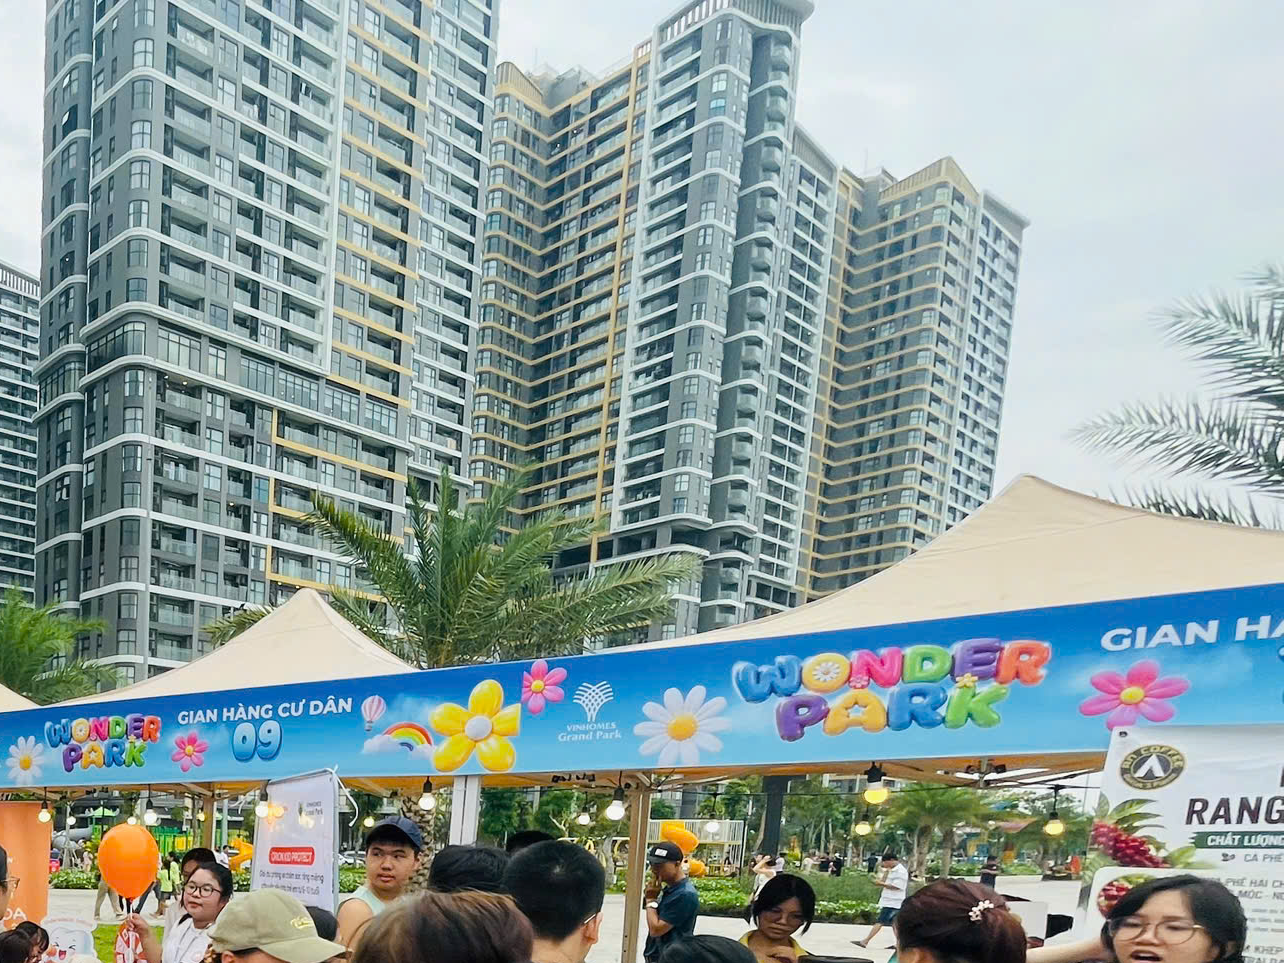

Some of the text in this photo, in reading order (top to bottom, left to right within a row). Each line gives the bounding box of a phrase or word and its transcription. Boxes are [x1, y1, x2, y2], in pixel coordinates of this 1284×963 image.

[1100, 620, 1220, 651] GIAN
[731, 637, 1052, 704] WONDER
[177, 695, 353, 725] GIAN HÀNG CƯ DÂN
[774, 680, 1011, 742] PARK
[44, 713, 162, 749] WONDER
[232, 720, 282, 762] 09
[558, 729, 621, 741] Grand Park
[566, 721, 616, 731] VINHOMES
[62, 738, 147, 772] PARK
[1185, 796, 1284, 825] RANG
[1207, 832, 1241, 846] CHẤT
